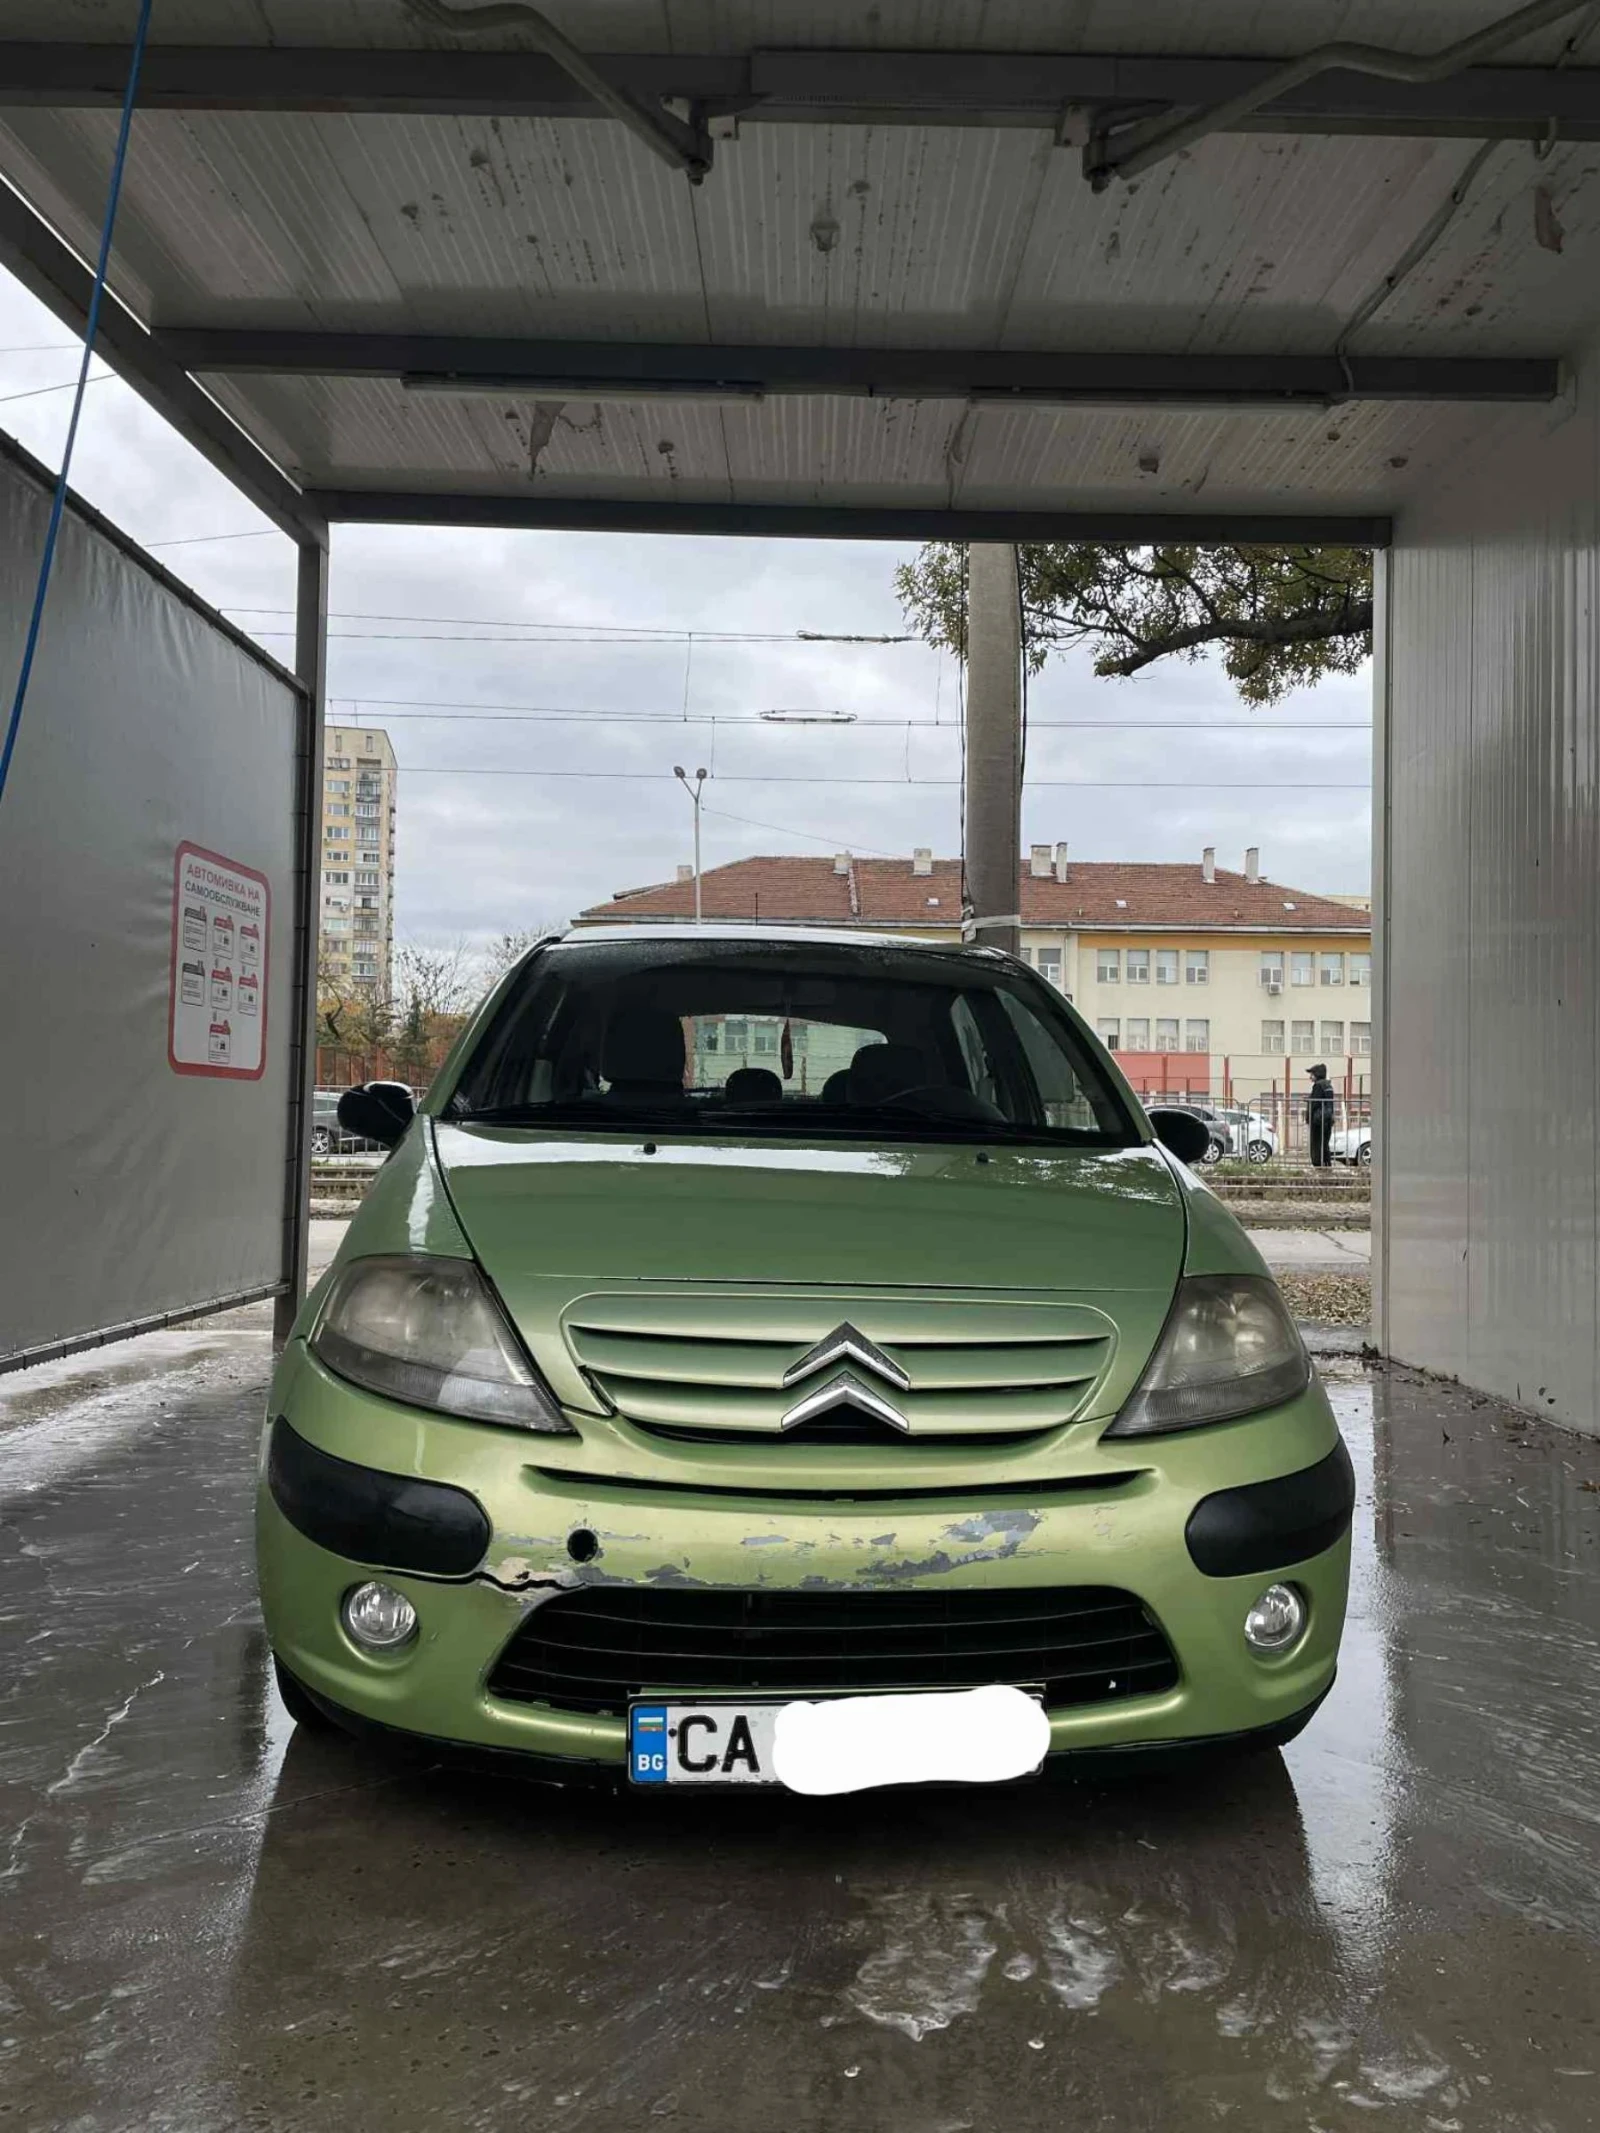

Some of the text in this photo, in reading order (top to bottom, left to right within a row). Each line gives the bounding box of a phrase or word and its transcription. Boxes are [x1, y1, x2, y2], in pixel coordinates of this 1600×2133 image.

[186, 864, 261, 903] АВТОМИВКА НА
[638, 1754, 665, 1772] BG
[677, 1714, 761, 1774] CA
